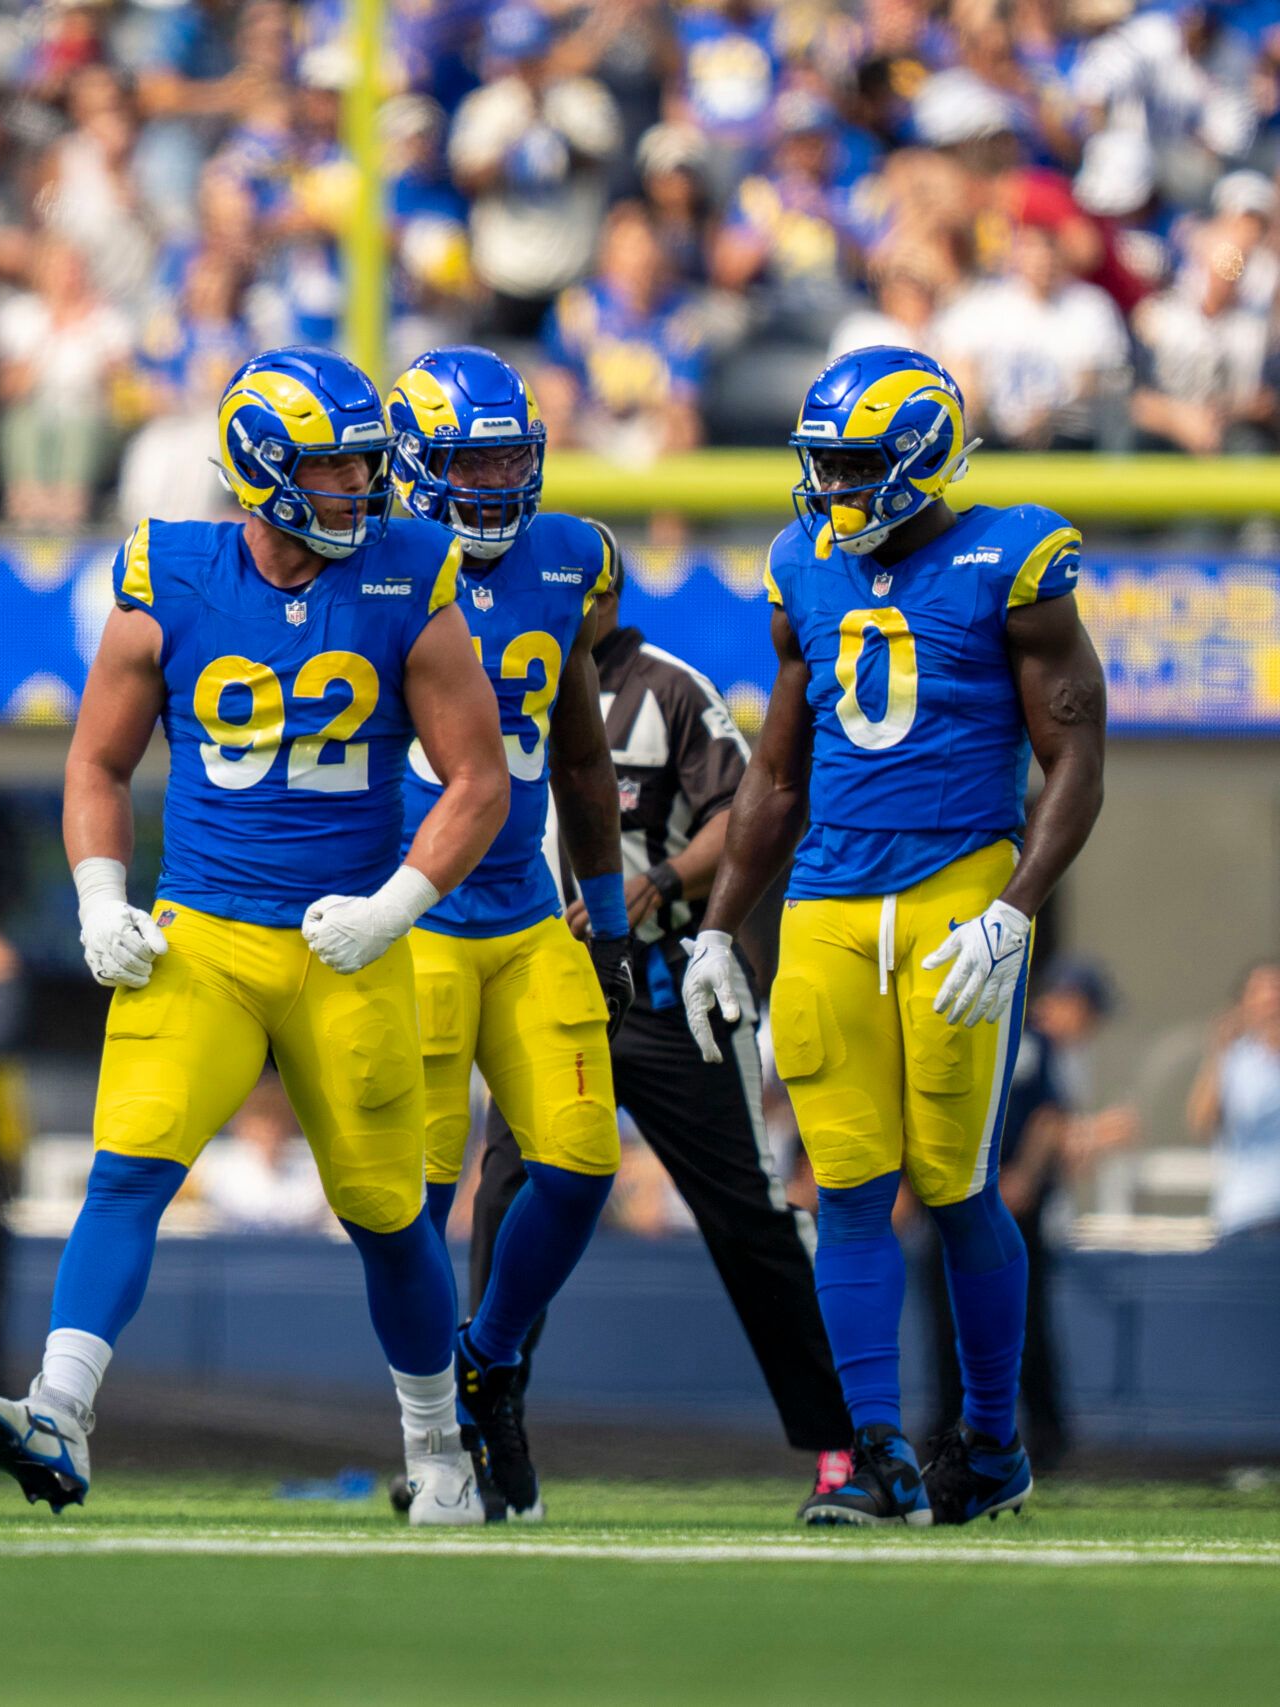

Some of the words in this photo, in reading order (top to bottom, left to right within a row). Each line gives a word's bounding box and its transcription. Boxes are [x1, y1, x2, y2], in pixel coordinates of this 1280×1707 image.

[952, 552, 1000, 565] RAMS
[541, 571, 583, 584] RAMS
[361, 583, 412, 595] RAMS
[835, 606, 918, 750] 0
[193, 650, 380, 793] 92
